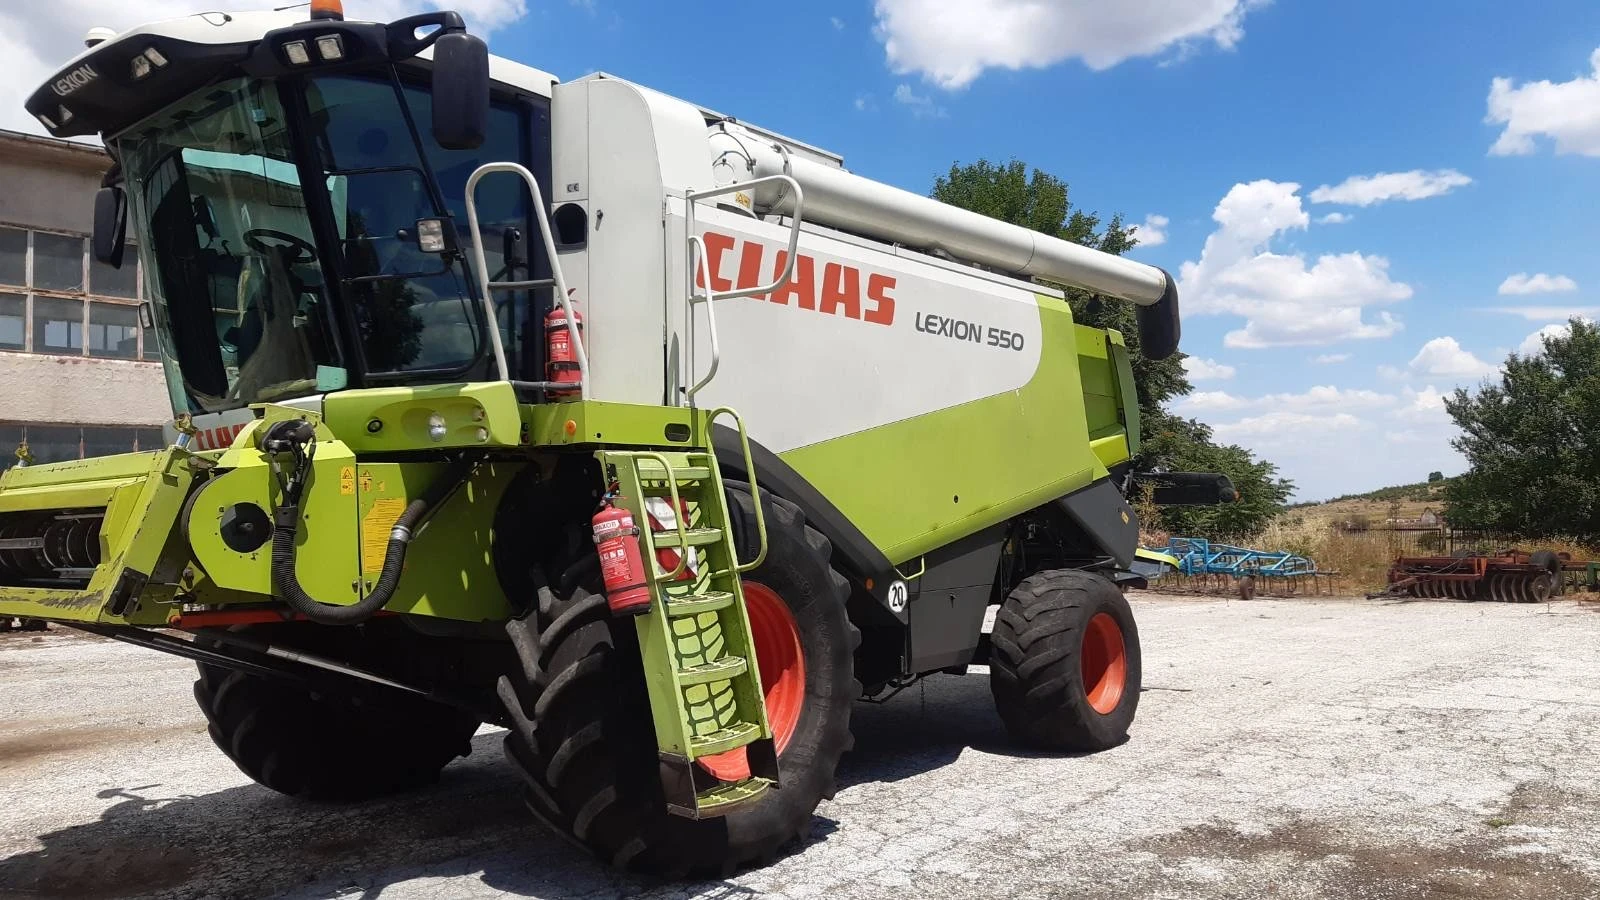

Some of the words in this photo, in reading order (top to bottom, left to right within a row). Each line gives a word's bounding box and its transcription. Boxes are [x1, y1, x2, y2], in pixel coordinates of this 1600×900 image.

[51, 63, 98, 96] LEXION
[696, 231, 897, 326] CLAAS
[915, 311, 983, 343] LEXION
[987, 327, 1025, 351] 550
[892, 585, 904, 607] 20
